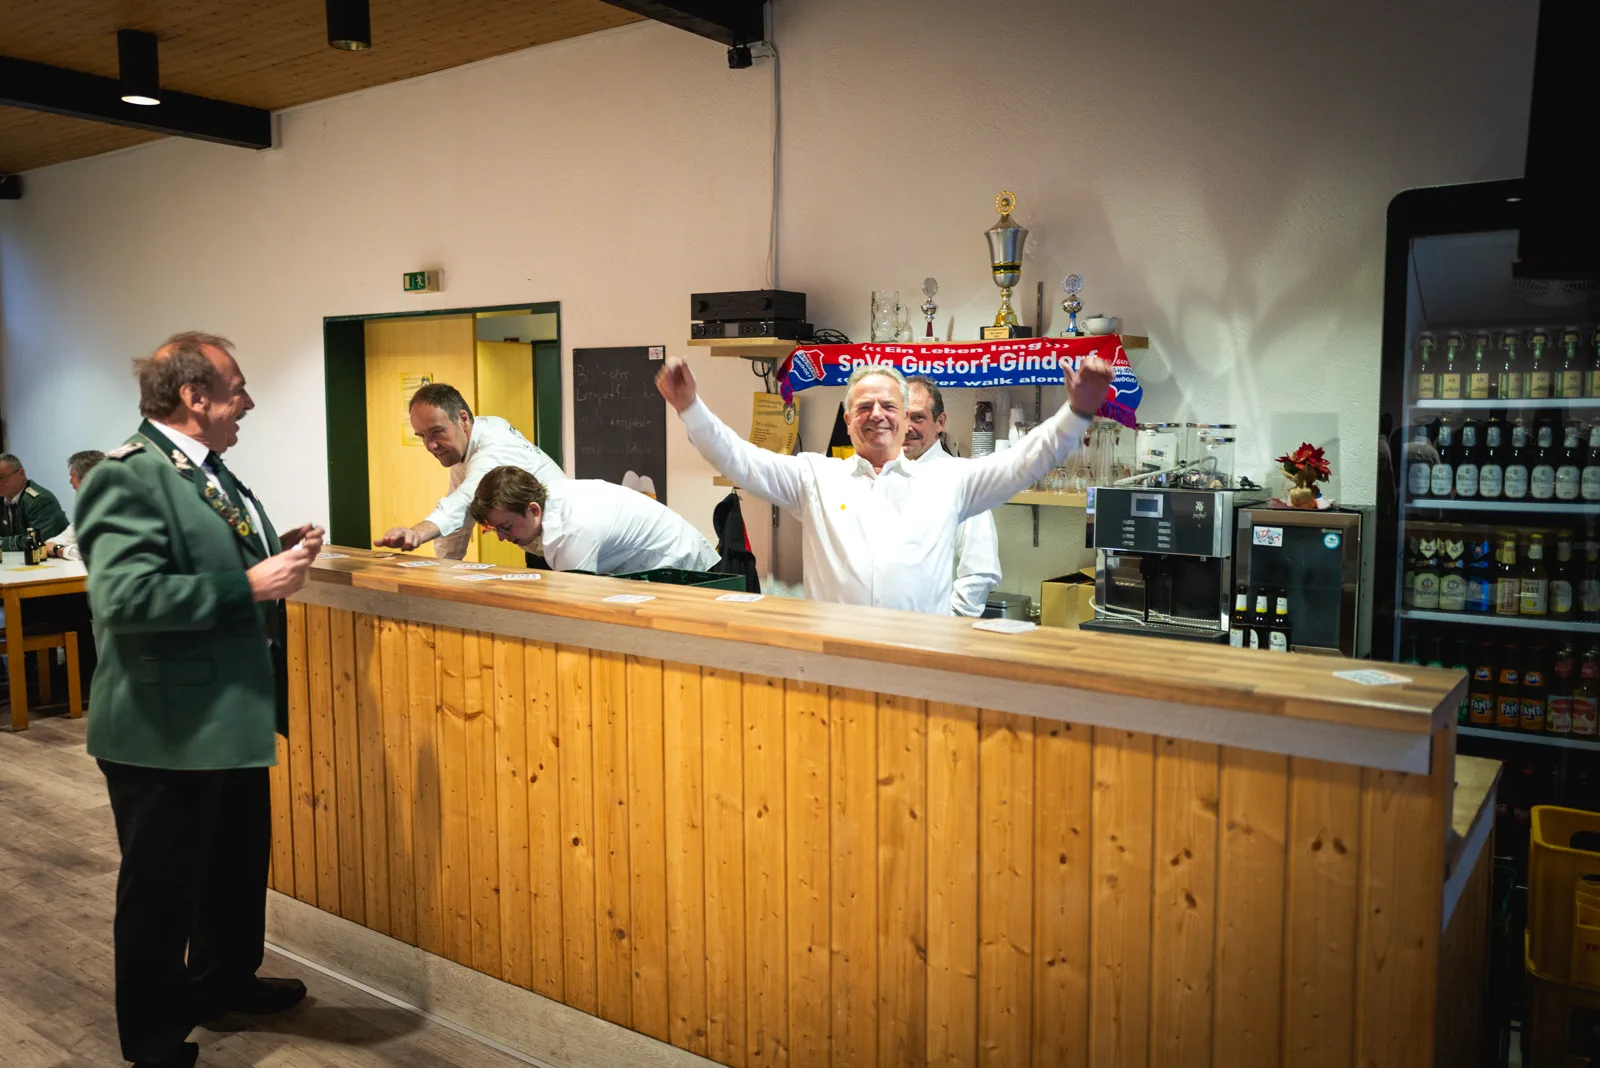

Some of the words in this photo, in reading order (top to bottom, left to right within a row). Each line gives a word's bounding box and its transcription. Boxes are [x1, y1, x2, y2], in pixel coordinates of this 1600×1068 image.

[885, 346, 914, 354] Ein
[990, 342, 1042, 351] lang
[963, 377, 1013, 386] walk
